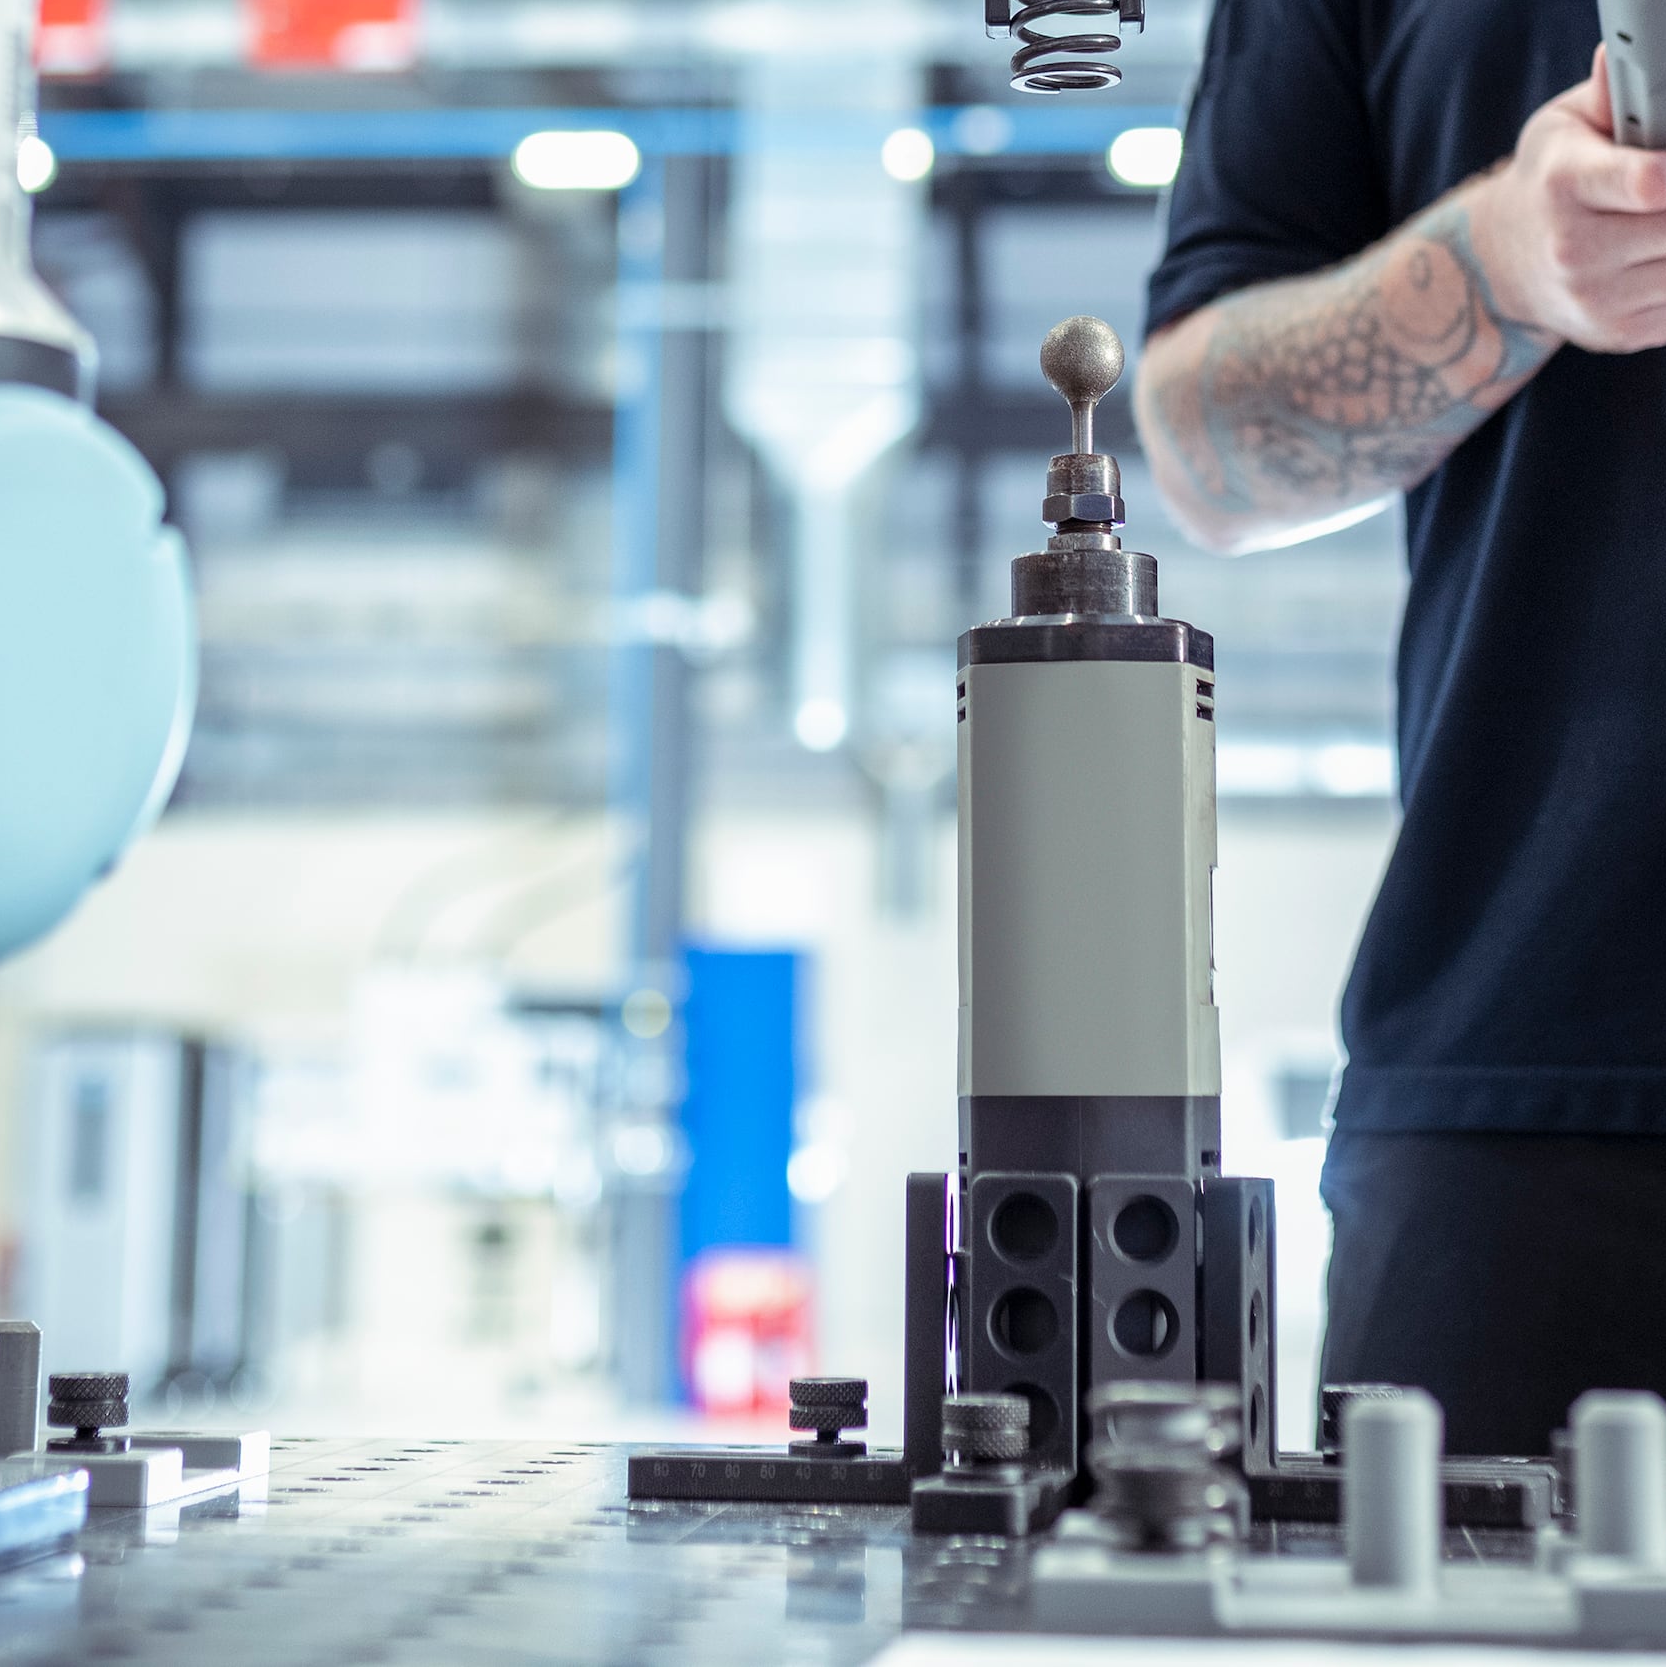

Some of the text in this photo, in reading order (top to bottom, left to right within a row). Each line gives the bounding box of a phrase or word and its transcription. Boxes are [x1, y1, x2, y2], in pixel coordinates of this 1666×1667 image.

[690, 1463, 706, 1478] 70
[796, 1464, 811, 1480] 40
[831, 1465, 847, 1480] 30
[867, 1465, 883, 1481] 20
